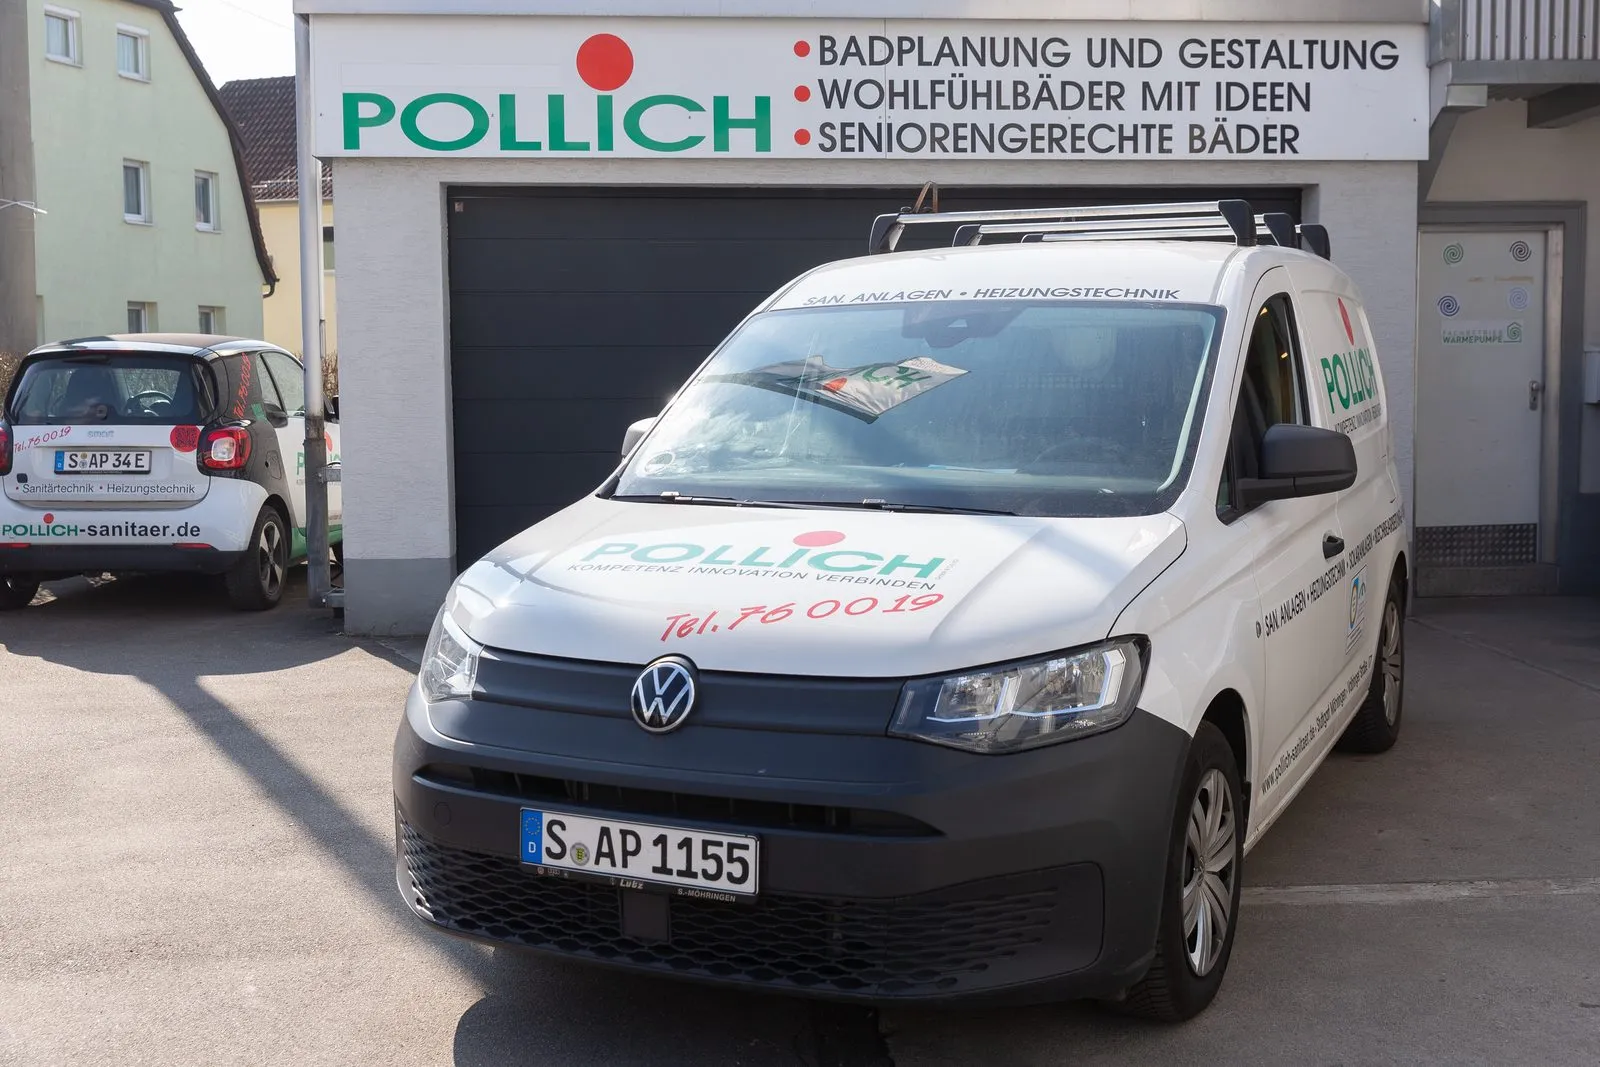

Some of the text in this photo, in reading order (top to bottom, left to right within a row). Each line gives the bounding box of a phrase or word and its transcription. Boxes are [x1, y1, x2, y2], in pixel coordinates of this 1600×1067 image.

[819, 35, 1400, 71] BADPLANUNG UND GESTALTUNG
[818, 73, 1312, 113] WOHLFÜHLBÄDER MIT IDEEN
[342, 92, 772, 153] POLLICH
[817, 118, 1300, 155] SENIORENGERECHTE BÄDER
[803, 287, 1180, 306] SAN. ANLAGEN HEIZUNGSTECHNIK
[1320, 348, 1379, 415] POLLICH
[68, 453, 79, 469] S
[88, 453, 109, 469] AP
[22, 483, 195, 495] Sanitärtechnik Heizungstechnik
[2, 521, 201, 538] POLLICH-sanitaer.de
[567, 564, 936, 591] KOMPETENZ INNOVATION VERBINDEN
[580, 542, 946, 579] POLLICH
[660, 613, 719, 642] Tel.
[528, 819, 750, 885] D S AP 1155
